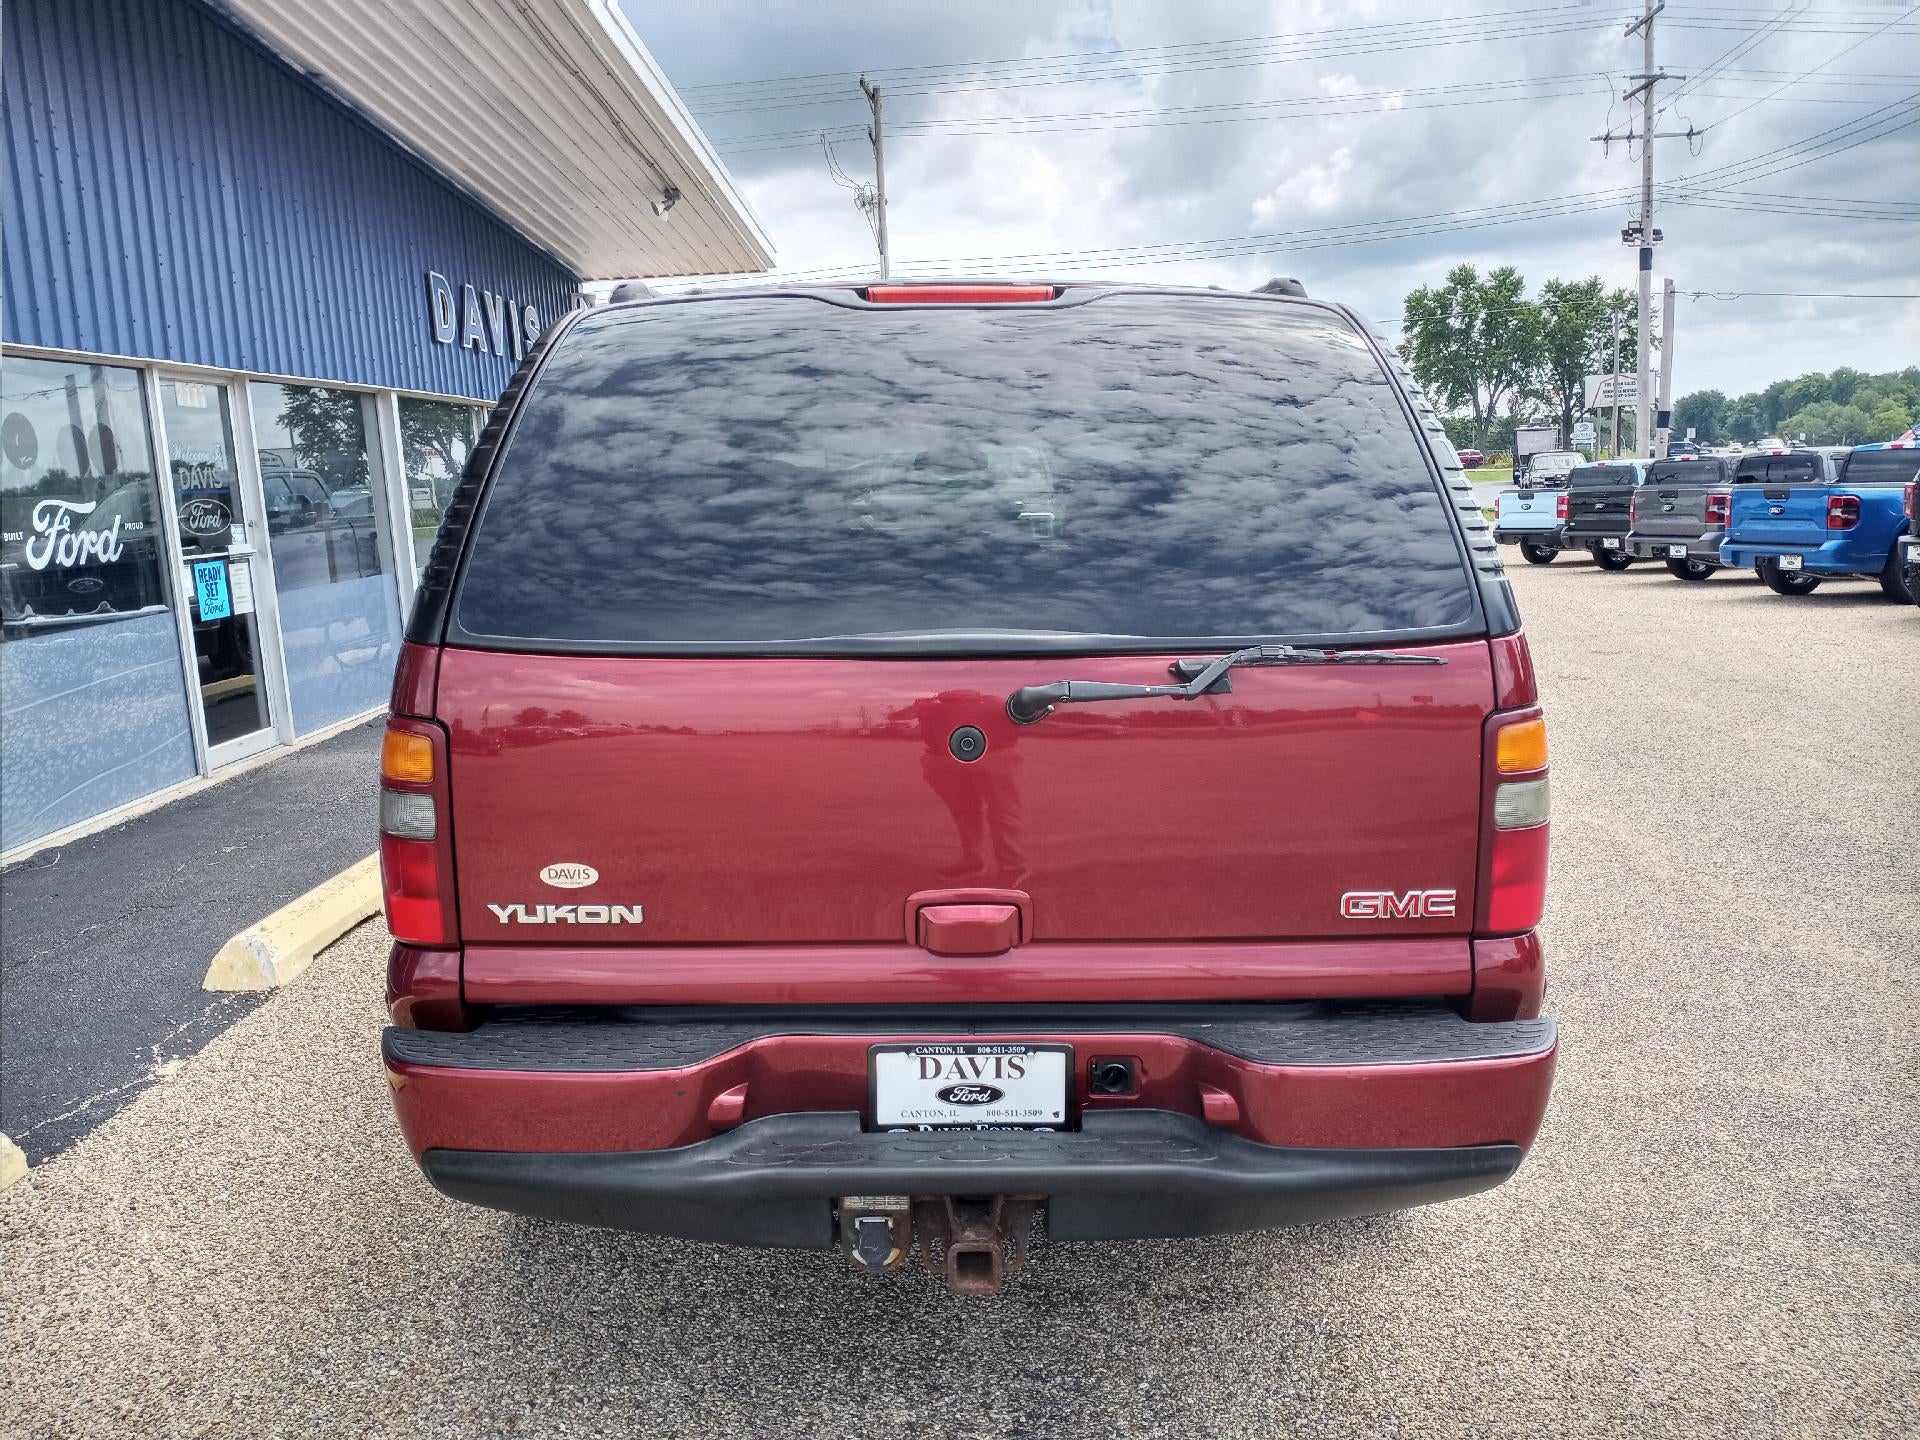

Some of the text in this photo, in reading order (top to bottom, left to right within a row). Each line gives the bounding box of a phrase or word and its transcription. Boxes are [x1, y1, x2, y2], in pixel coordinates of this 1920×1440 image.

[427, 270, 541, 361] DAVIS
[178, 464, 223, 490] DAVIS
[189, 502, 222, 529] Ford
[26, 499, 124, 571] Ford
[124, 521, 144, 531] PROUD
[3, 531, 24, 542] BUILT
[198, 565, 222, 584] READY
[204, 582, 219, 598] SET
[203, 597, 226, 616] Ford
[547, 867, 591, 880] DAVIS
[1340, 889, 1457, 919] GMC
[487, 903, 645, 925] YUKON
[915, 1046, 1026, 1055] CANTON, IL 800-511-3509
[917, 1056, 1026, 1080] DAVIS
[949, 1086, 991, 1102] Ford
[900, 1109, 947, 1119] CANTON,
[986, 1109, 1043, 1117] 800-511-3509
